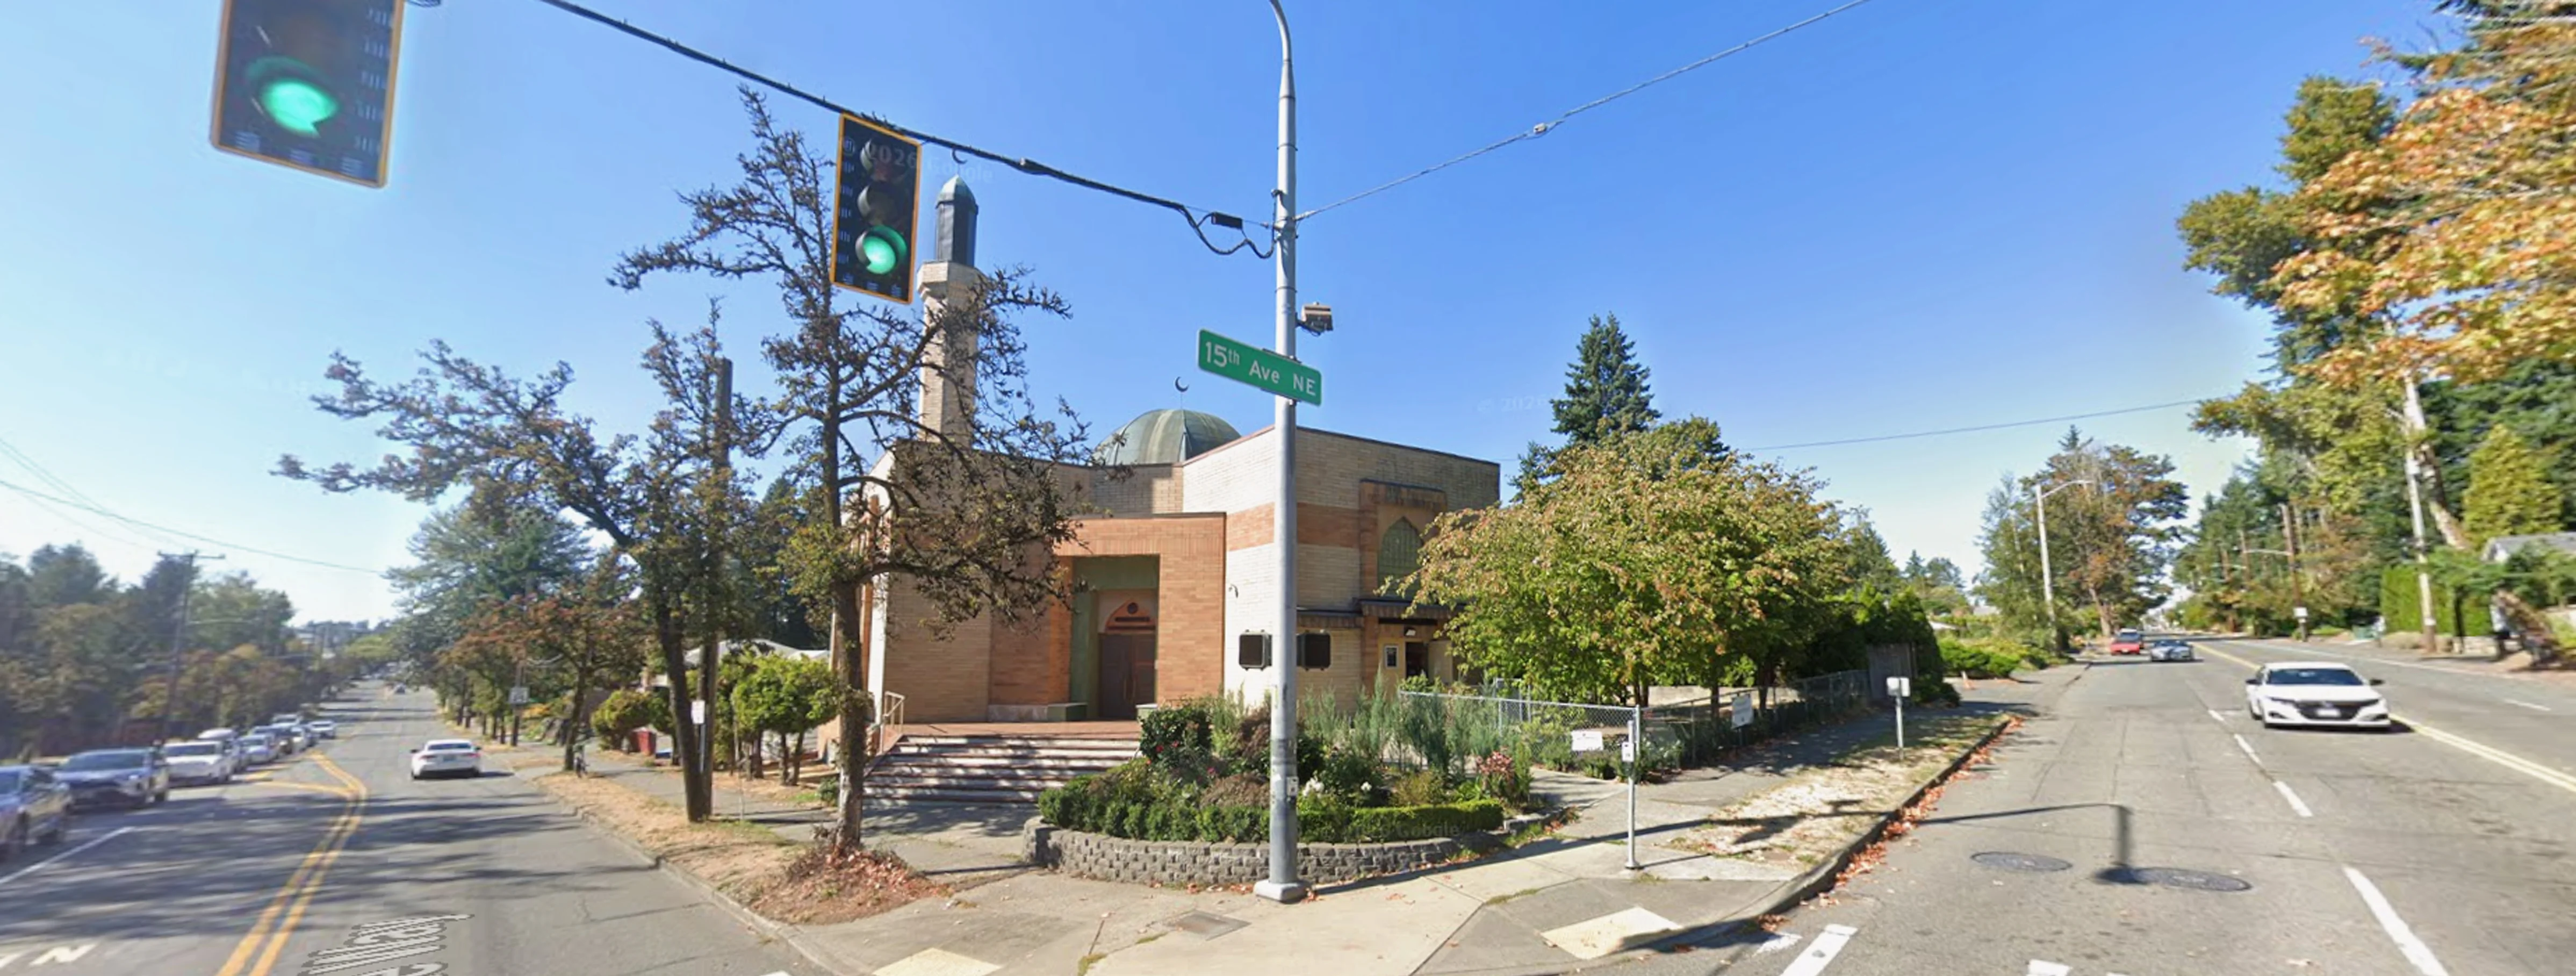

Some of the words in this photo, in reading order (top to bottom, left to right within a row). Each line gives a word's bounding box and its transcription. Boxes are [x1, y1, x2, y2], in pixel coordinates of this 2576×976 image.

[1206, 341, 1240, 368] 15th
[1249, 360, 1280, 384] Ave
[1292, 374, 1316, 396] NE
